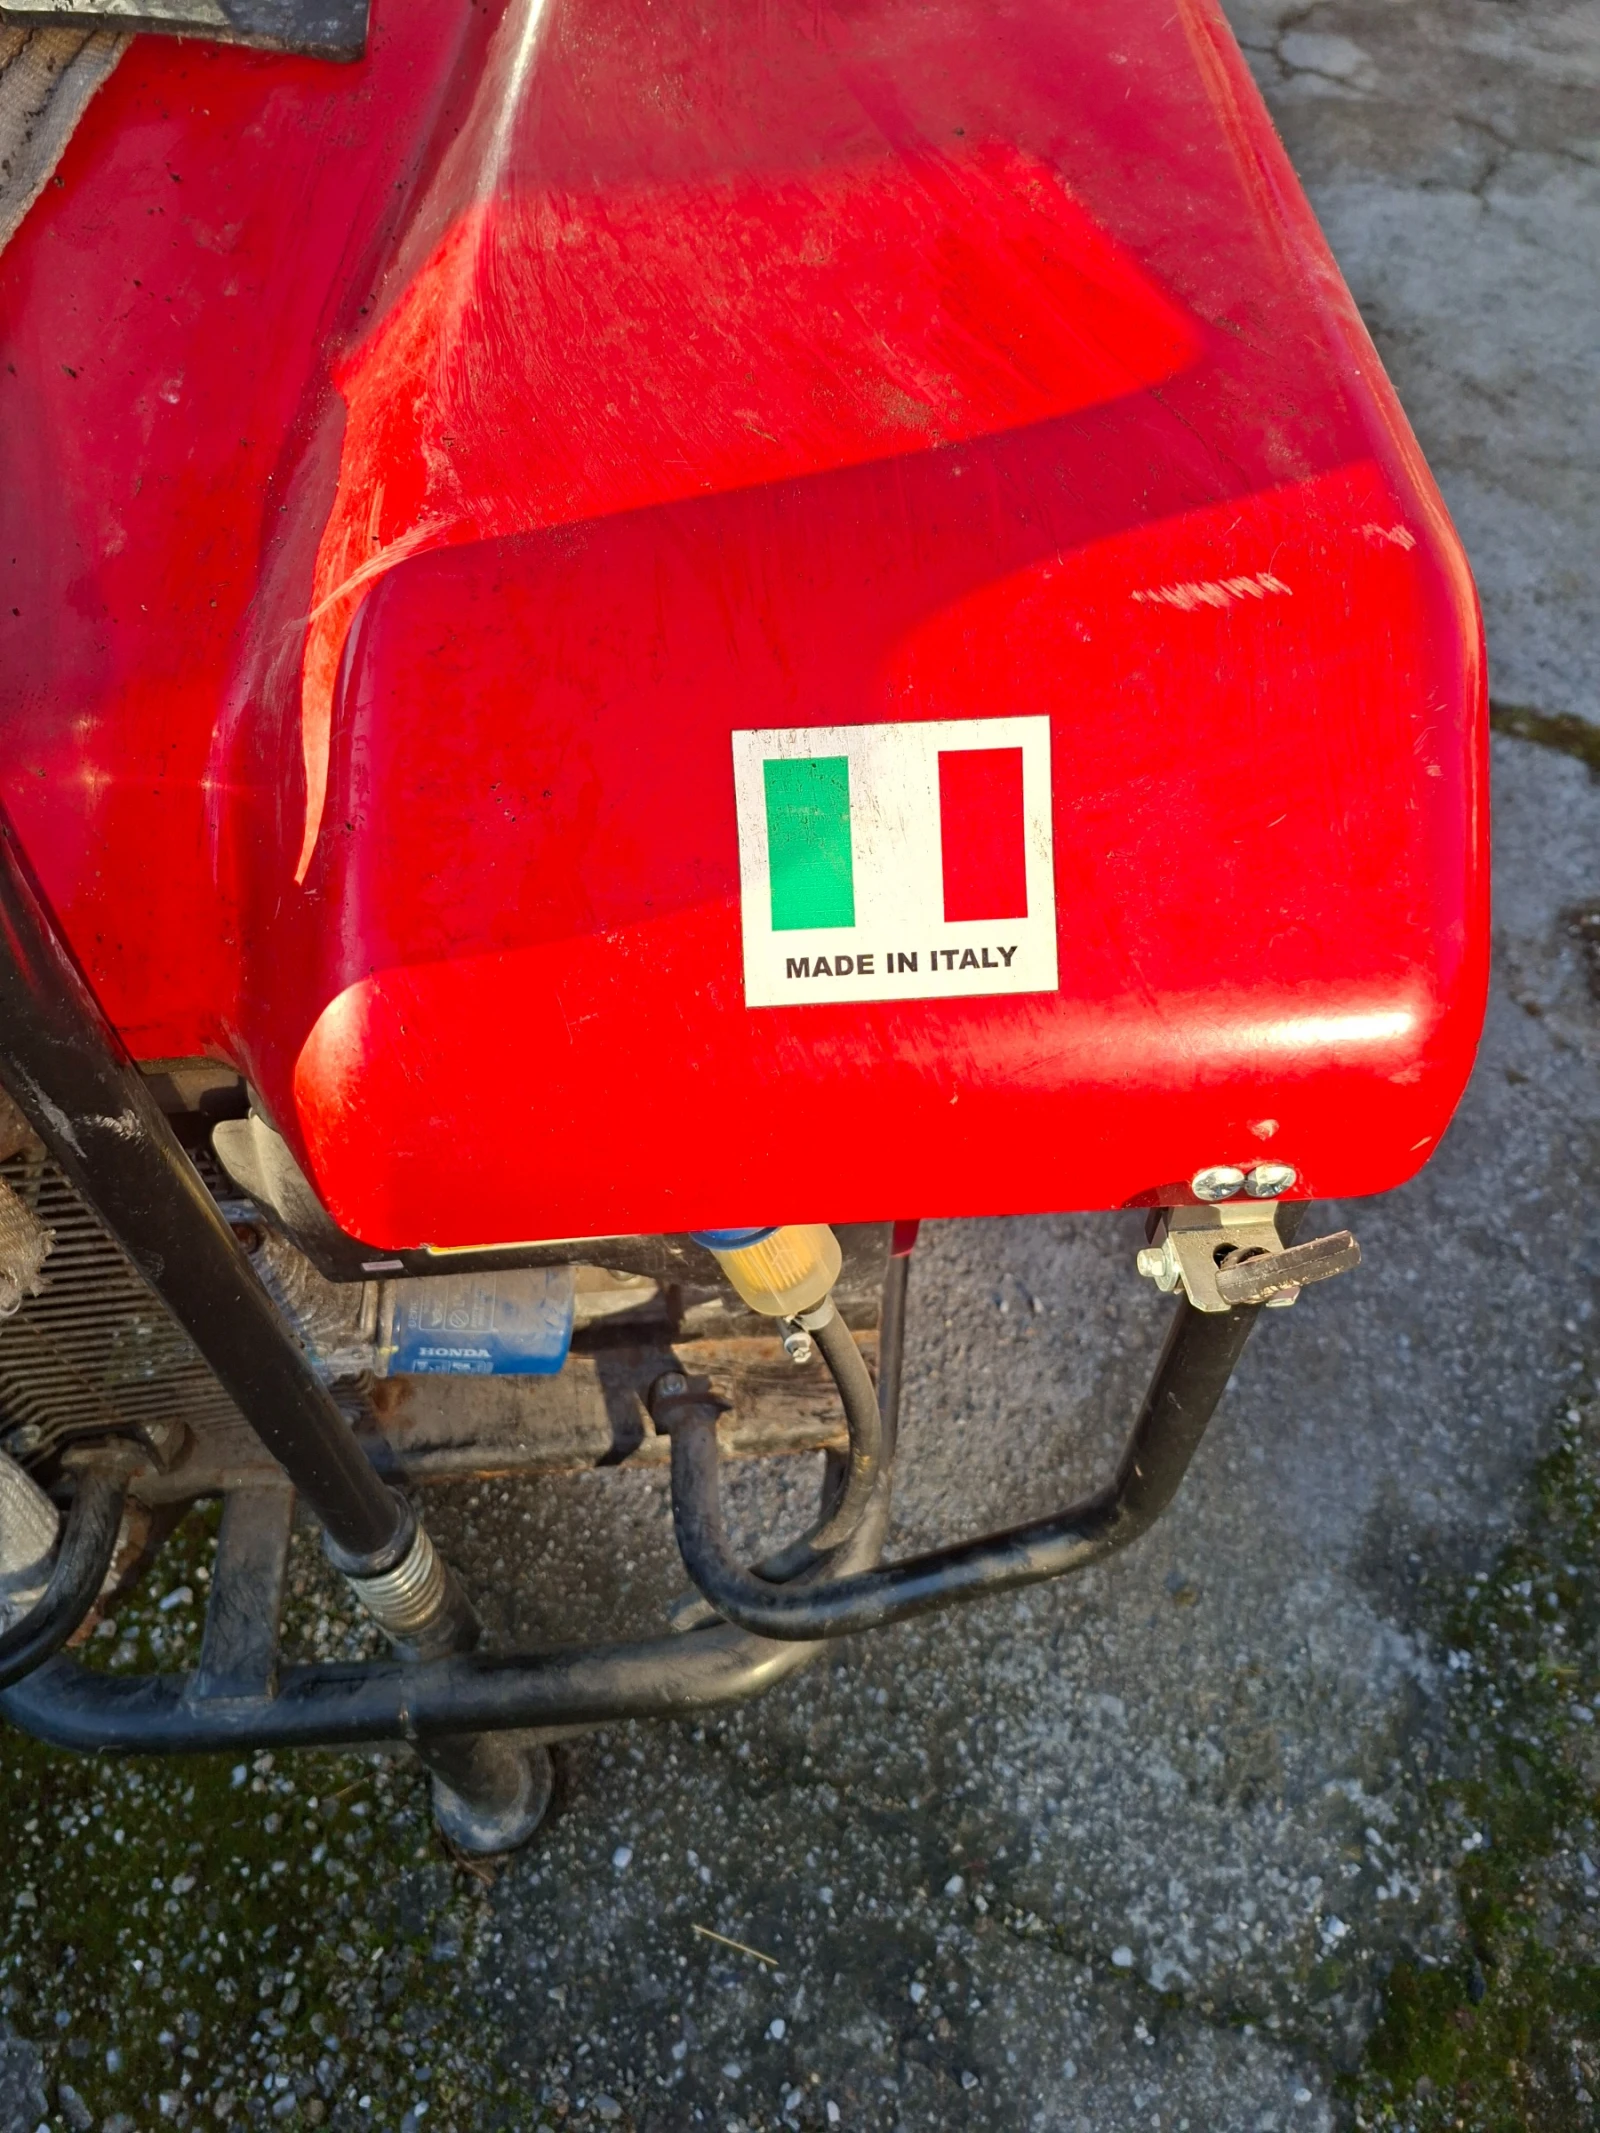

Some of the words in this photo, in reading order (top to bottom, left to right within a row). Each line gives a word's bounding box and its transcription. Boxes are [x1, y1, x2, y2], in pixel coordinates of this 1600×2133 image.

[785, 953, 875, 979] MADE
[886, 951, 918, 974] IN
[930, 945, 1018, 971] ITALY
[418, 1346, 492, 1358] HONDA
